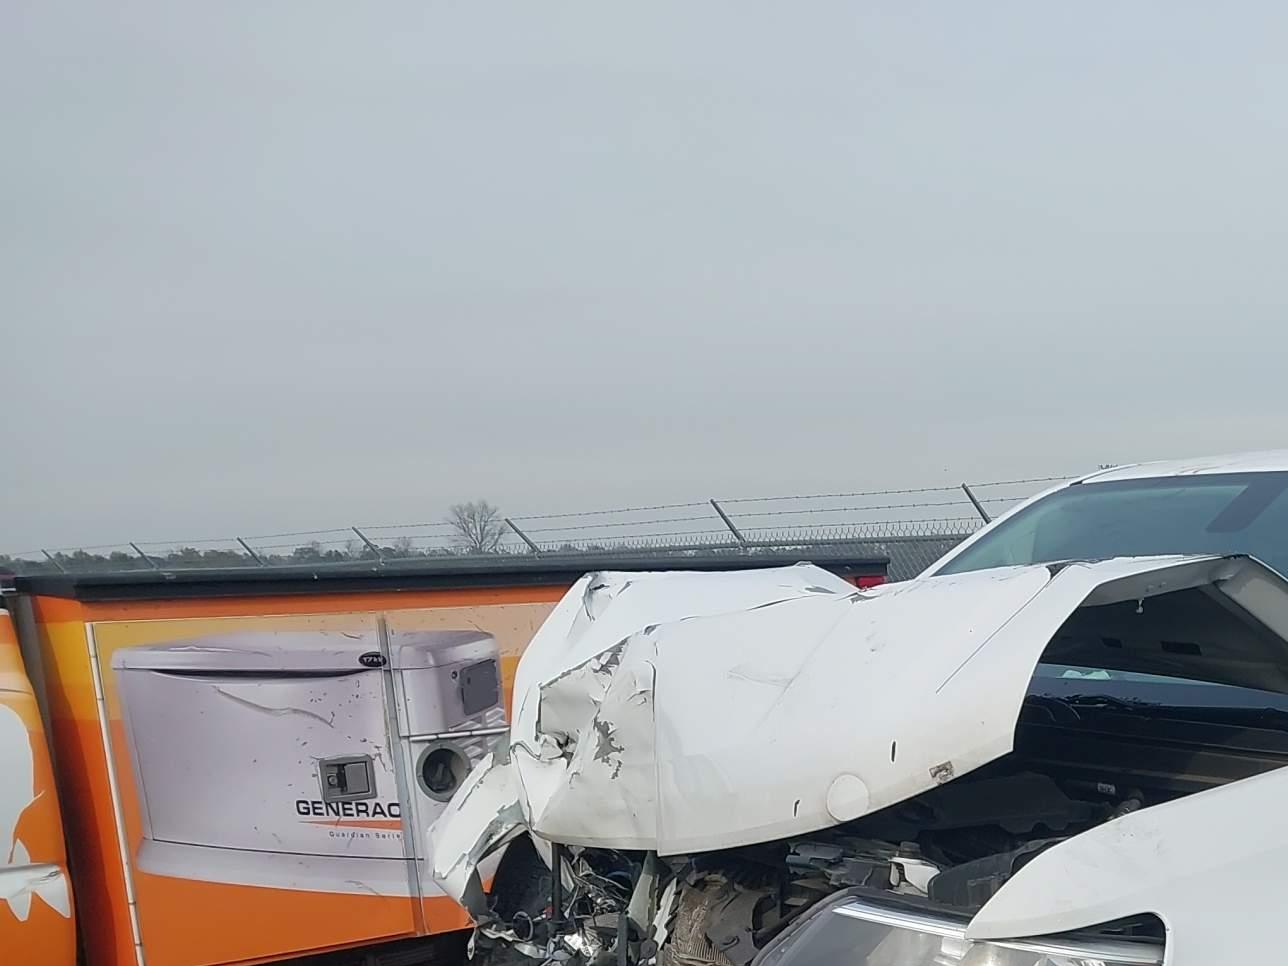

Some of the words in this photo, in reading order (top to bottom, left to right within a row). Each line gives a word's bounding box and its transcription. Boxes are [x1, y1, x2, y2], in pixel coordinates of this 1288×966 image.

[296, 800, 400, 818] GENERAC
[329, 831, 370, 839] Guardian
[375, 832, 402, 840] Serie
